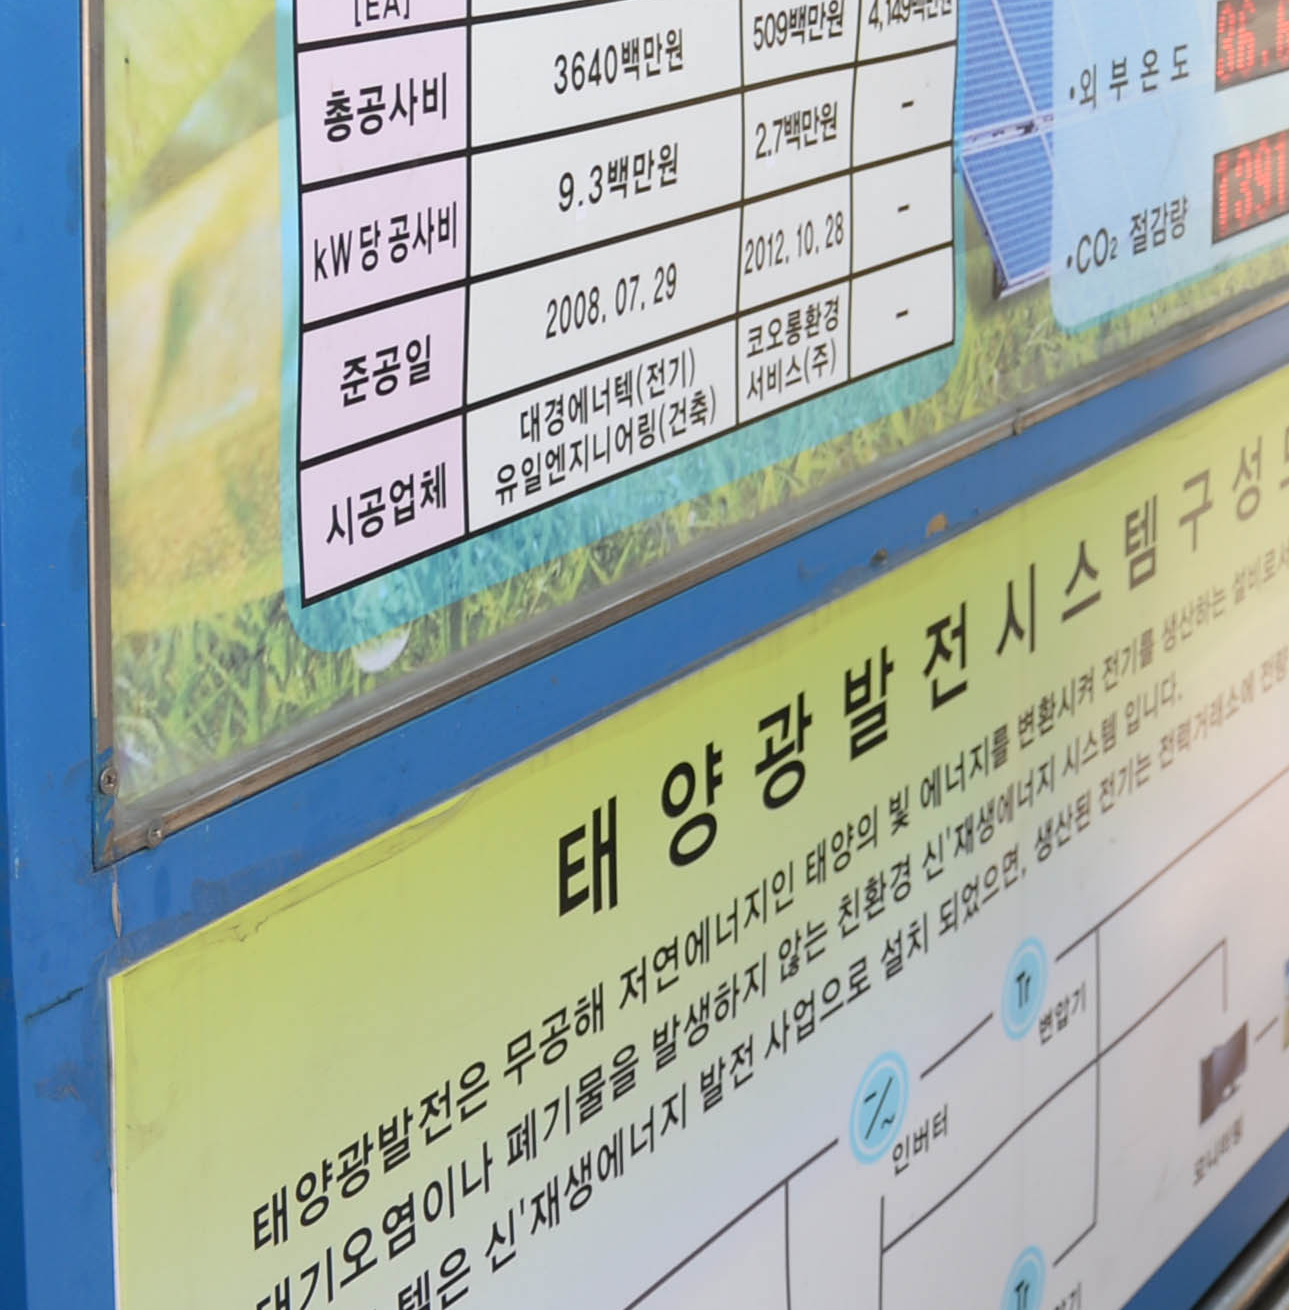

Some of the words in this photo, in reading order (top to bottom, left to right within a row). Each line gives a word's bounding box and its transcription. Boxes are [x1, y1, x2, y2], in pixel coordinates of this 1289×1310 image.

[553, 27, 684, 95] 3640백만원
[323, 71, 448, 143] 총공사비
[755, 101, 838, 160] 2.7백만원
[558, 142, 679, 213] 9.3백만원
[1129, 195, 1189, 258] 절감량
[745, 295, 841, 360] 코오롱환경
[340, 335, 432, 408] 준공일
[520, 347, 697, 444] 대경에너텍(전기)
[745, 337, 837, 402] 서비스(주)
[495, 384, 717, 506] 유일엔지니어링(건축)
[326, 462, 448, 547] 시공업체
[253, 1060, 490, 1250] 태양광발전은
[504, 982, 604, 1085] 무공해
[619, 860, 794, 1010] 저연에너지인
[806, 804, 878, 885] 태양의
[889, 784, 911, 836] 빛
[920, 723, 1009, 811] 에너지를
[1017, 663, 1094, 752] 변환시켜
[1101, 627, 1156, 693] 전기를
[507, 1044, 638, 1167] 폐기물을
[652, 952, 767, 1071] 발생하지
[779, 922, 827, 985] 않는
[837, 854, 912, 937] 친환경
[1061, 714, 1118, 778] 시스템
[1124, 671, 1184, 738] 입니다.
[700, 1034, 755, 1113] 발전
[764, 956, 871, 1060] 사업으로
[880, 912, 930, 981] 설치
[1034, 797, 1092, 864] 생산된
[1099, 750, 1153, 816] 전기는
[1038, 982, 1088, 1047] 변압기
[891, 1103, 950, 1177] 인버터
